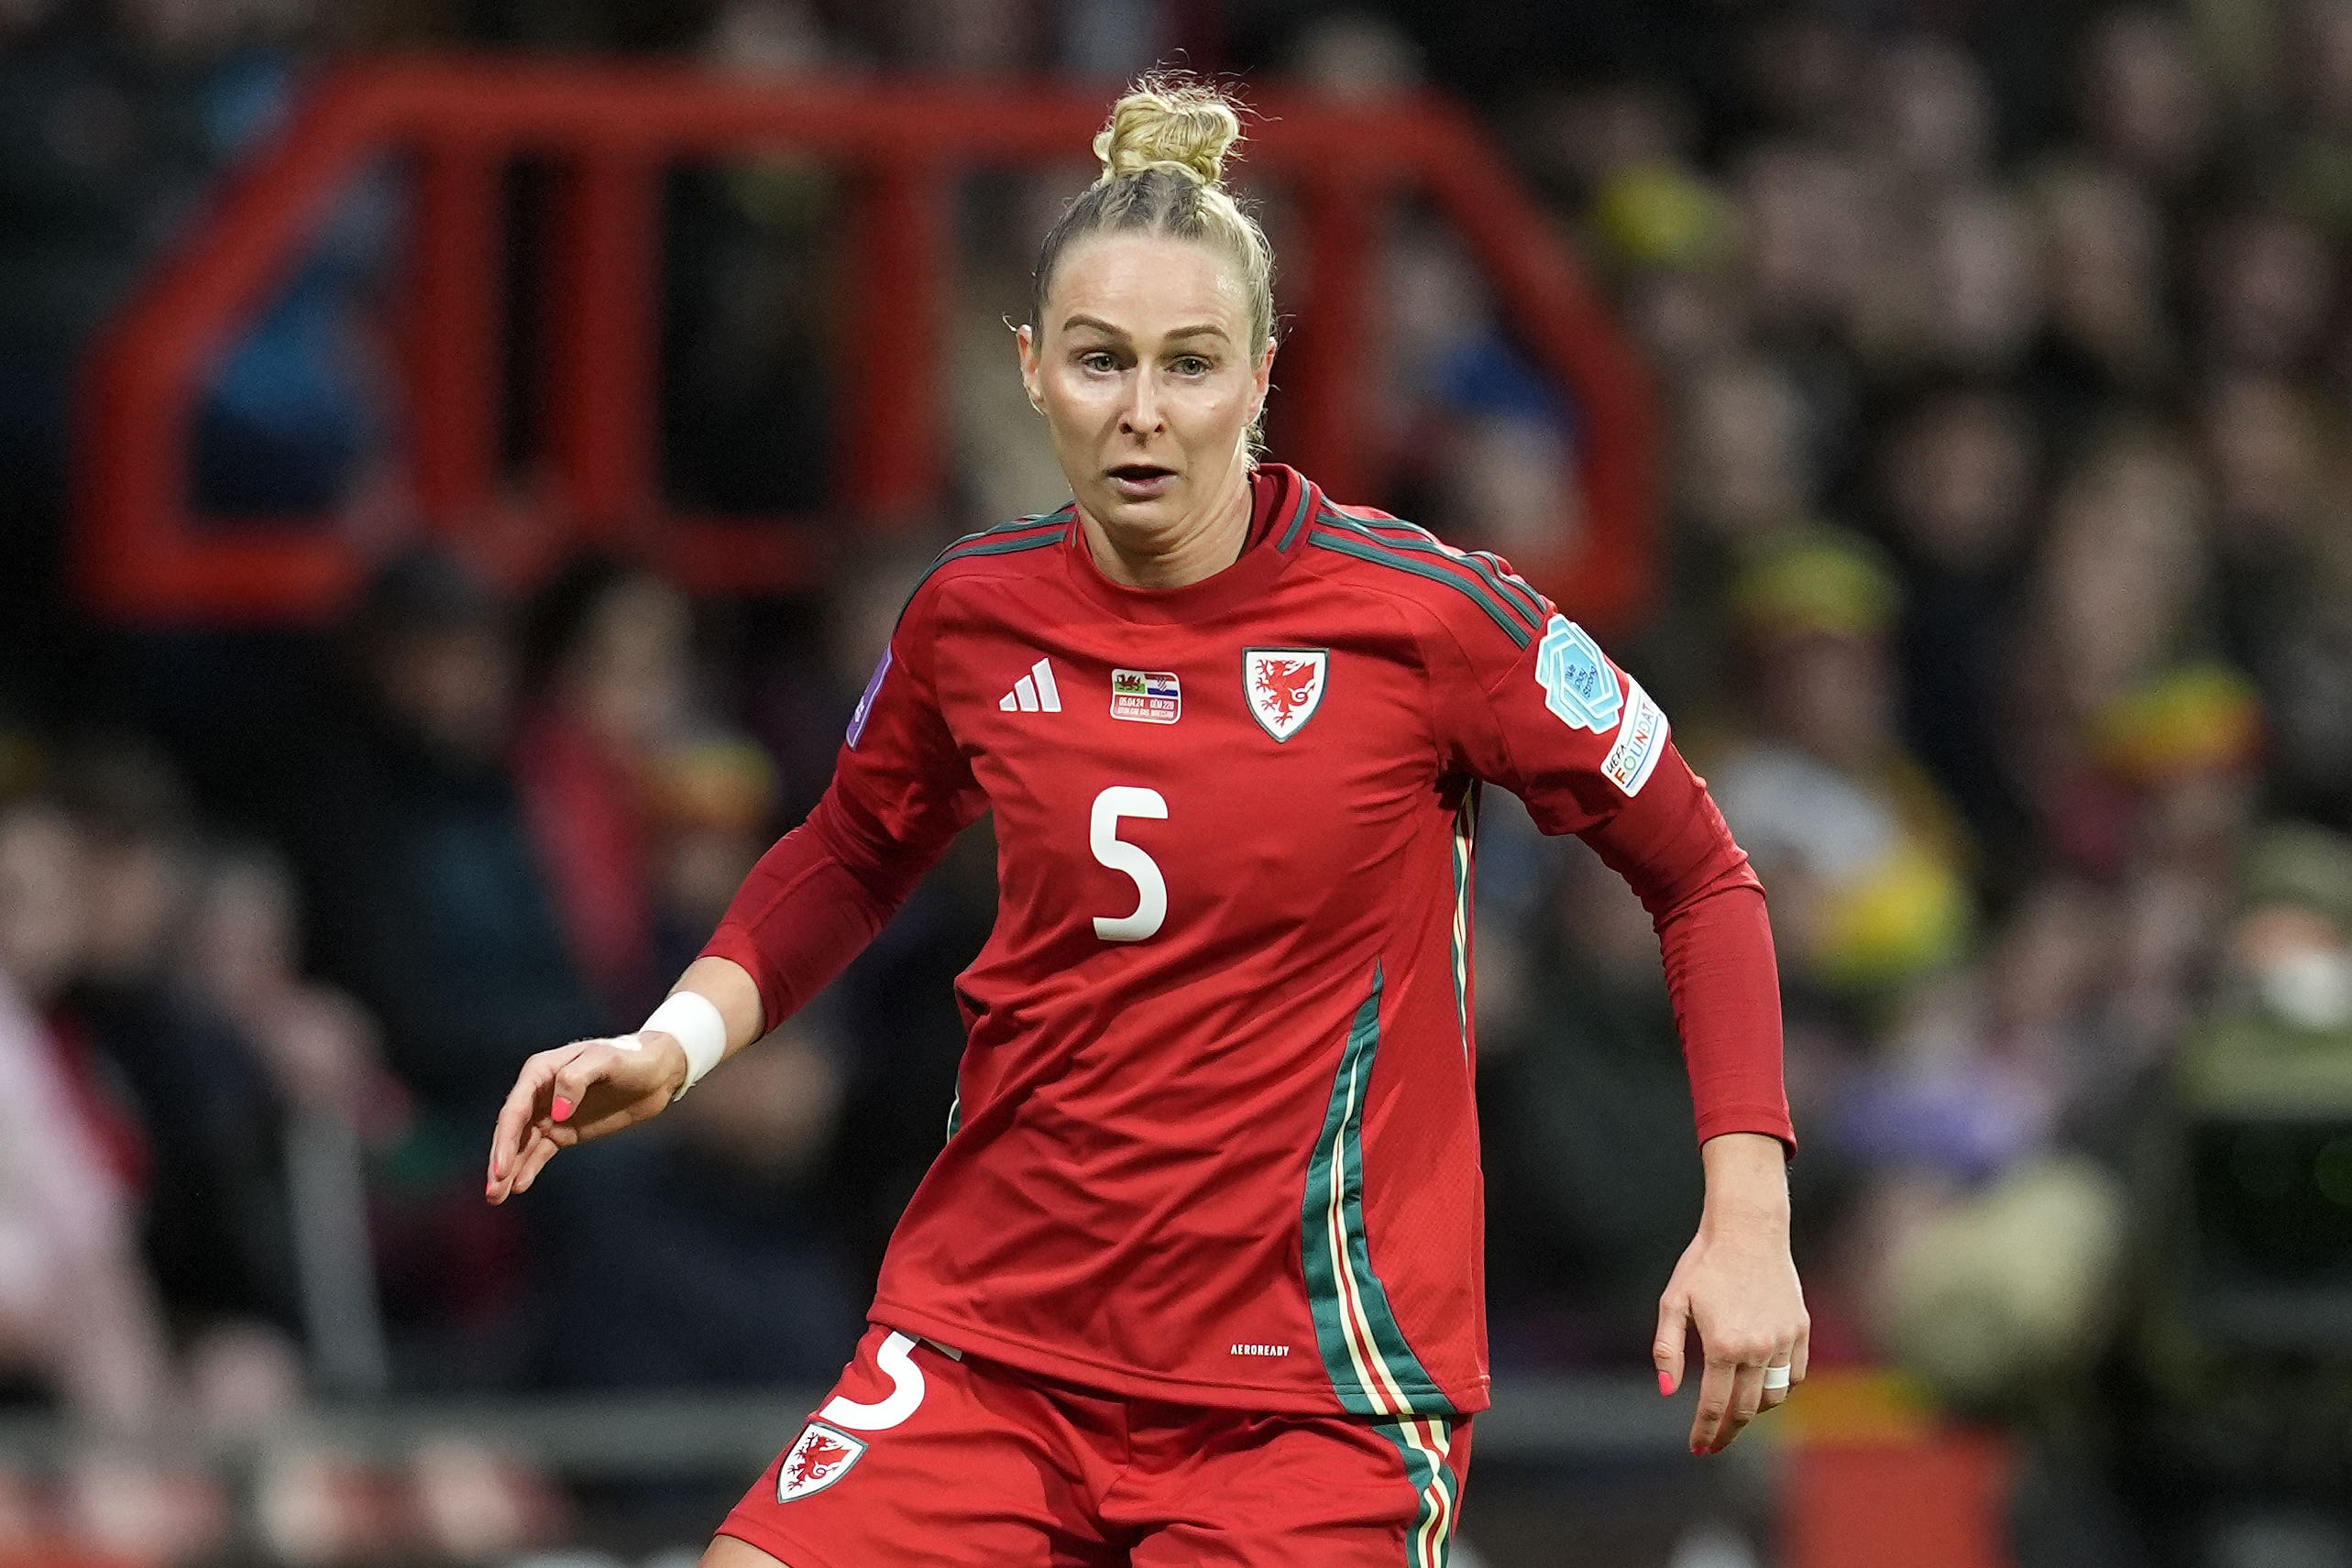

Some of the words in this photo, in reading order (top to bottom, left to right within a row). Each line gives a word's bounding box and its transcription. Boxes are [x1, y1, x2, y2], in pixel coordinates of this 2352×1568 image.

[1606, 743, 1626, 773] UEFA
[1614, 701, 1655, 784] FOUNDAT
[1090, 785, 1169, 942] 5
[819, 1331, 962, 1431] 5
[1230, 1343, 1290, 1357] AEROREADY
